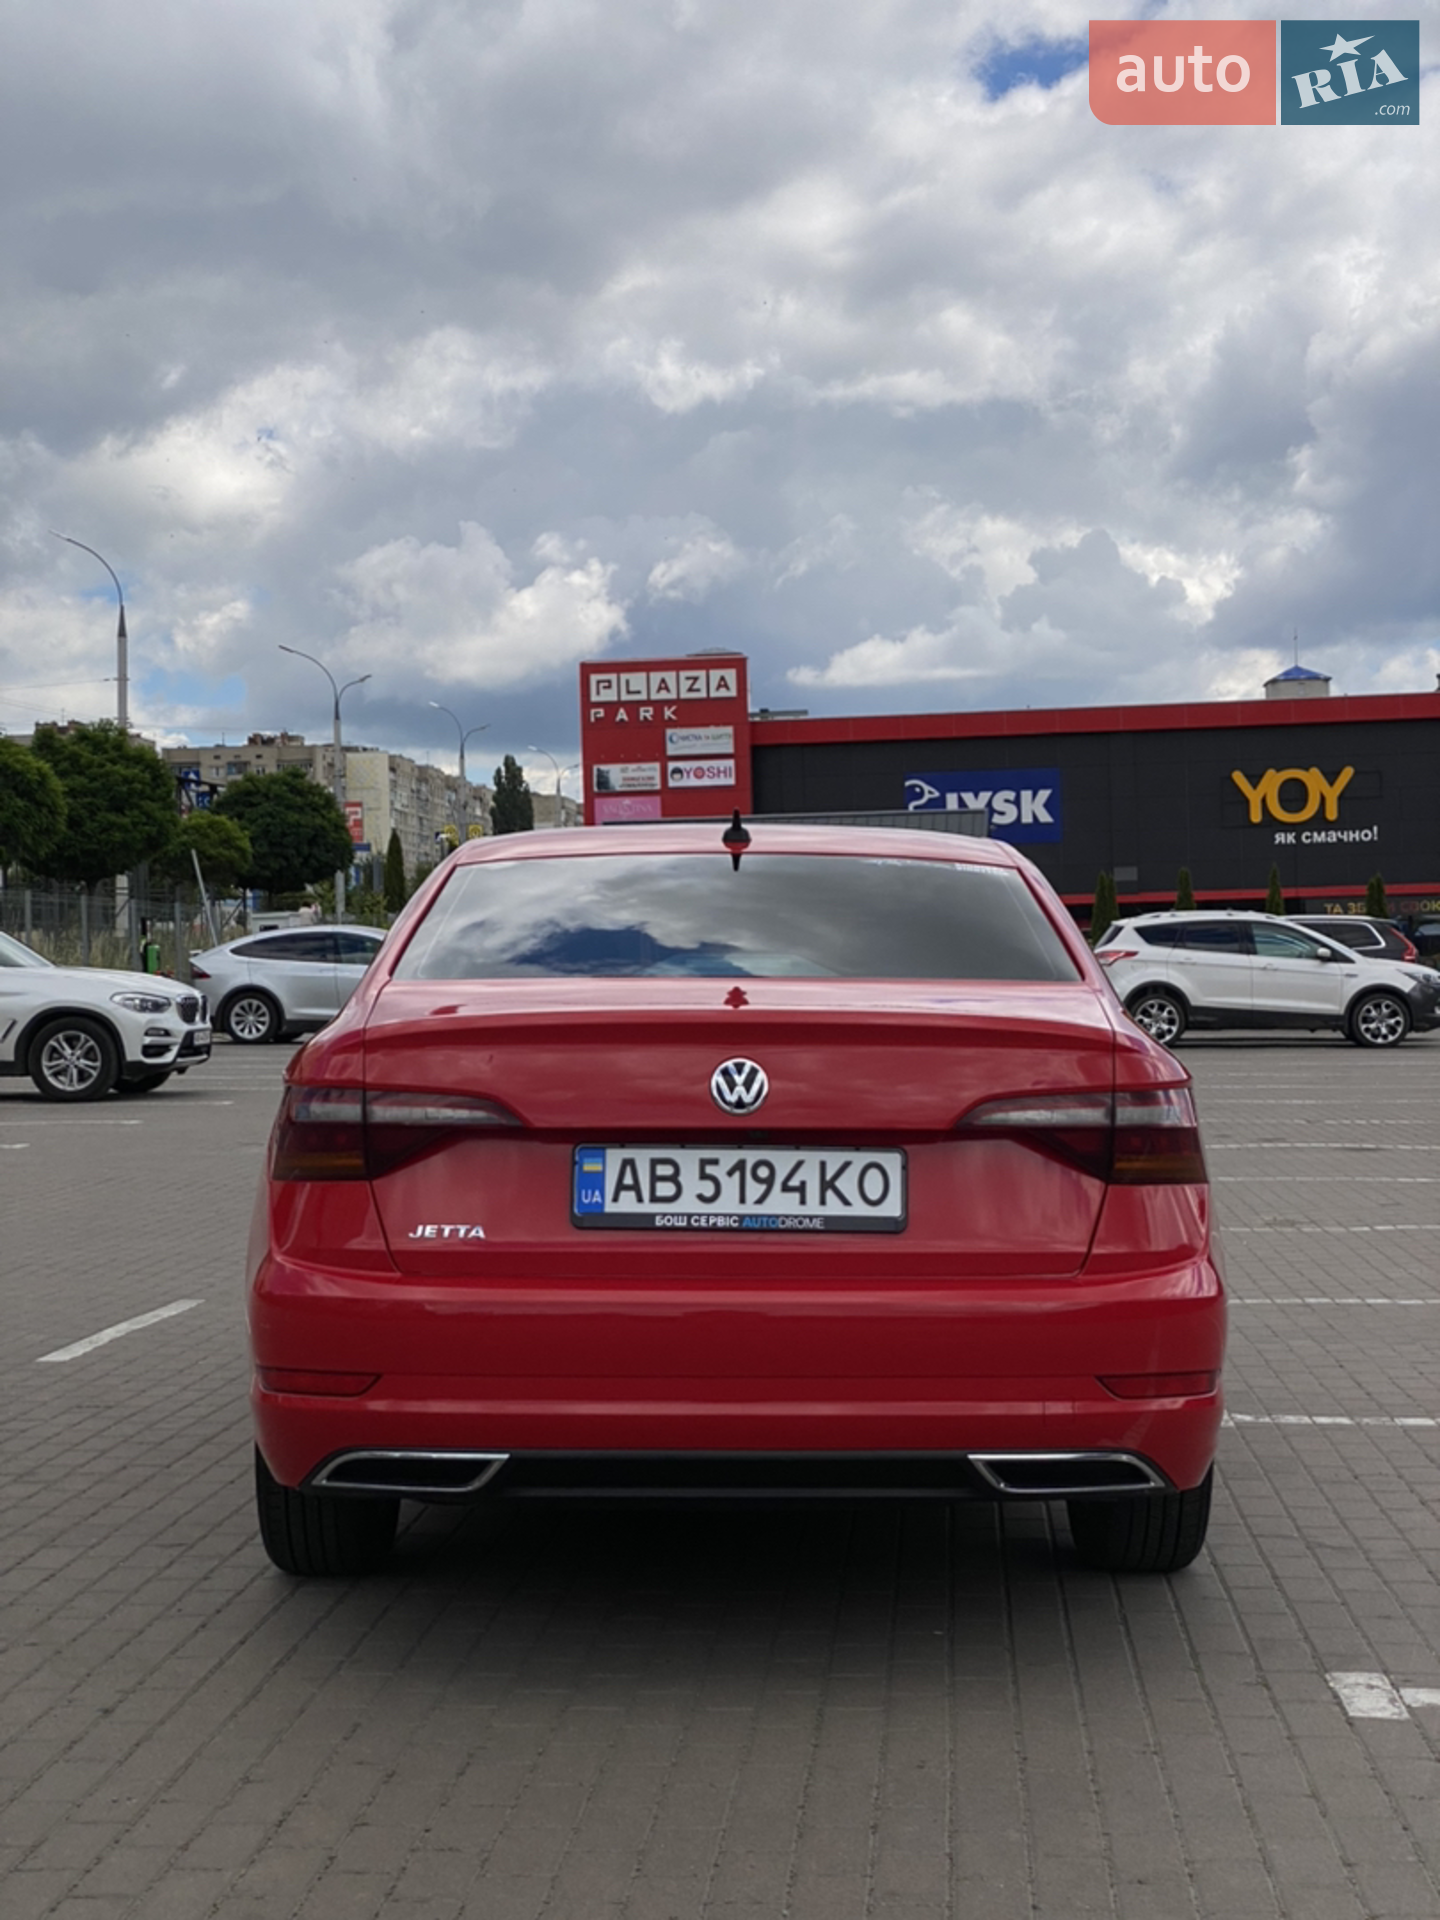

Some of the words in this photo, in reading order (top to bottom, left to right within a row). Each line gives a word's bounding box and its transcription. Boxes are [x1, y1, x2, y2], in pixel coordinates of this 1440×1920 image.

[595, 675, 731, 696] PLAZA
[590, 705, 678, 722] PARK
[683, 765, 733, 779] YOSHI
[1231, 765, 1355, 823] YOY
[1274, 831, 1297, 844] як
[1301, 825, 1379, 843] смачно!
[581, 1189, 602, 1203] UA
[655, 1215, 687, 1226] БОШ
[691, 1215, 739, 1227] СЕРВІС
[742, 1216, 825, 1229] AUTODROME
[408, 1224, 486, 1238] JETTA
